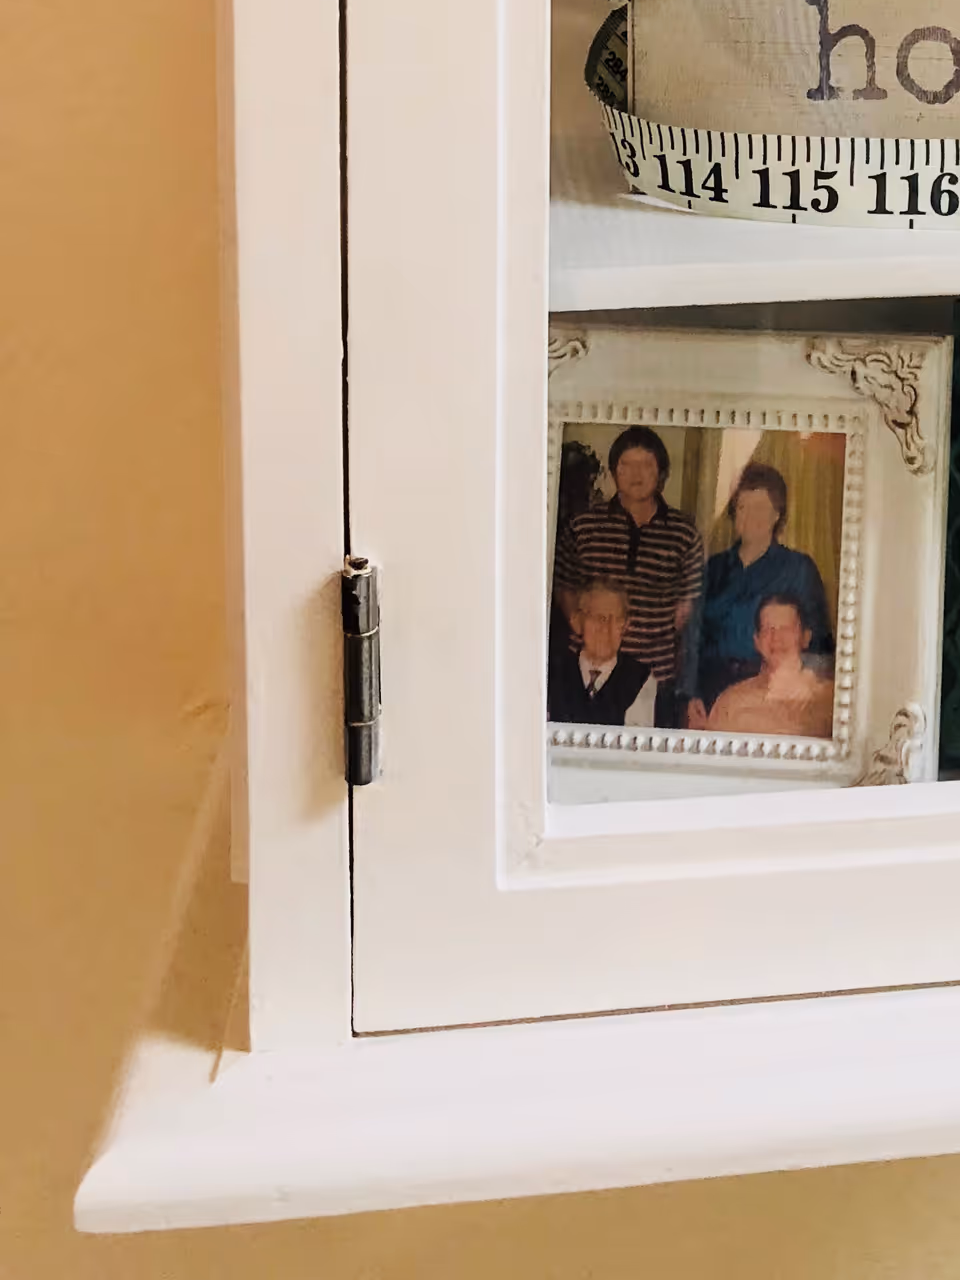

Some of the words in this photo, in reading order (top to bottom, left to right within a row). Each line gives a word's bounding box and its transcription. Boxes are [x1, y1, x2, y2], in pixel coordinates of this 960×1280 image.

[653, 153, 728, 203] 114
[752, 167, 839, 213] 115
[867, 172, 960, 216] 116
